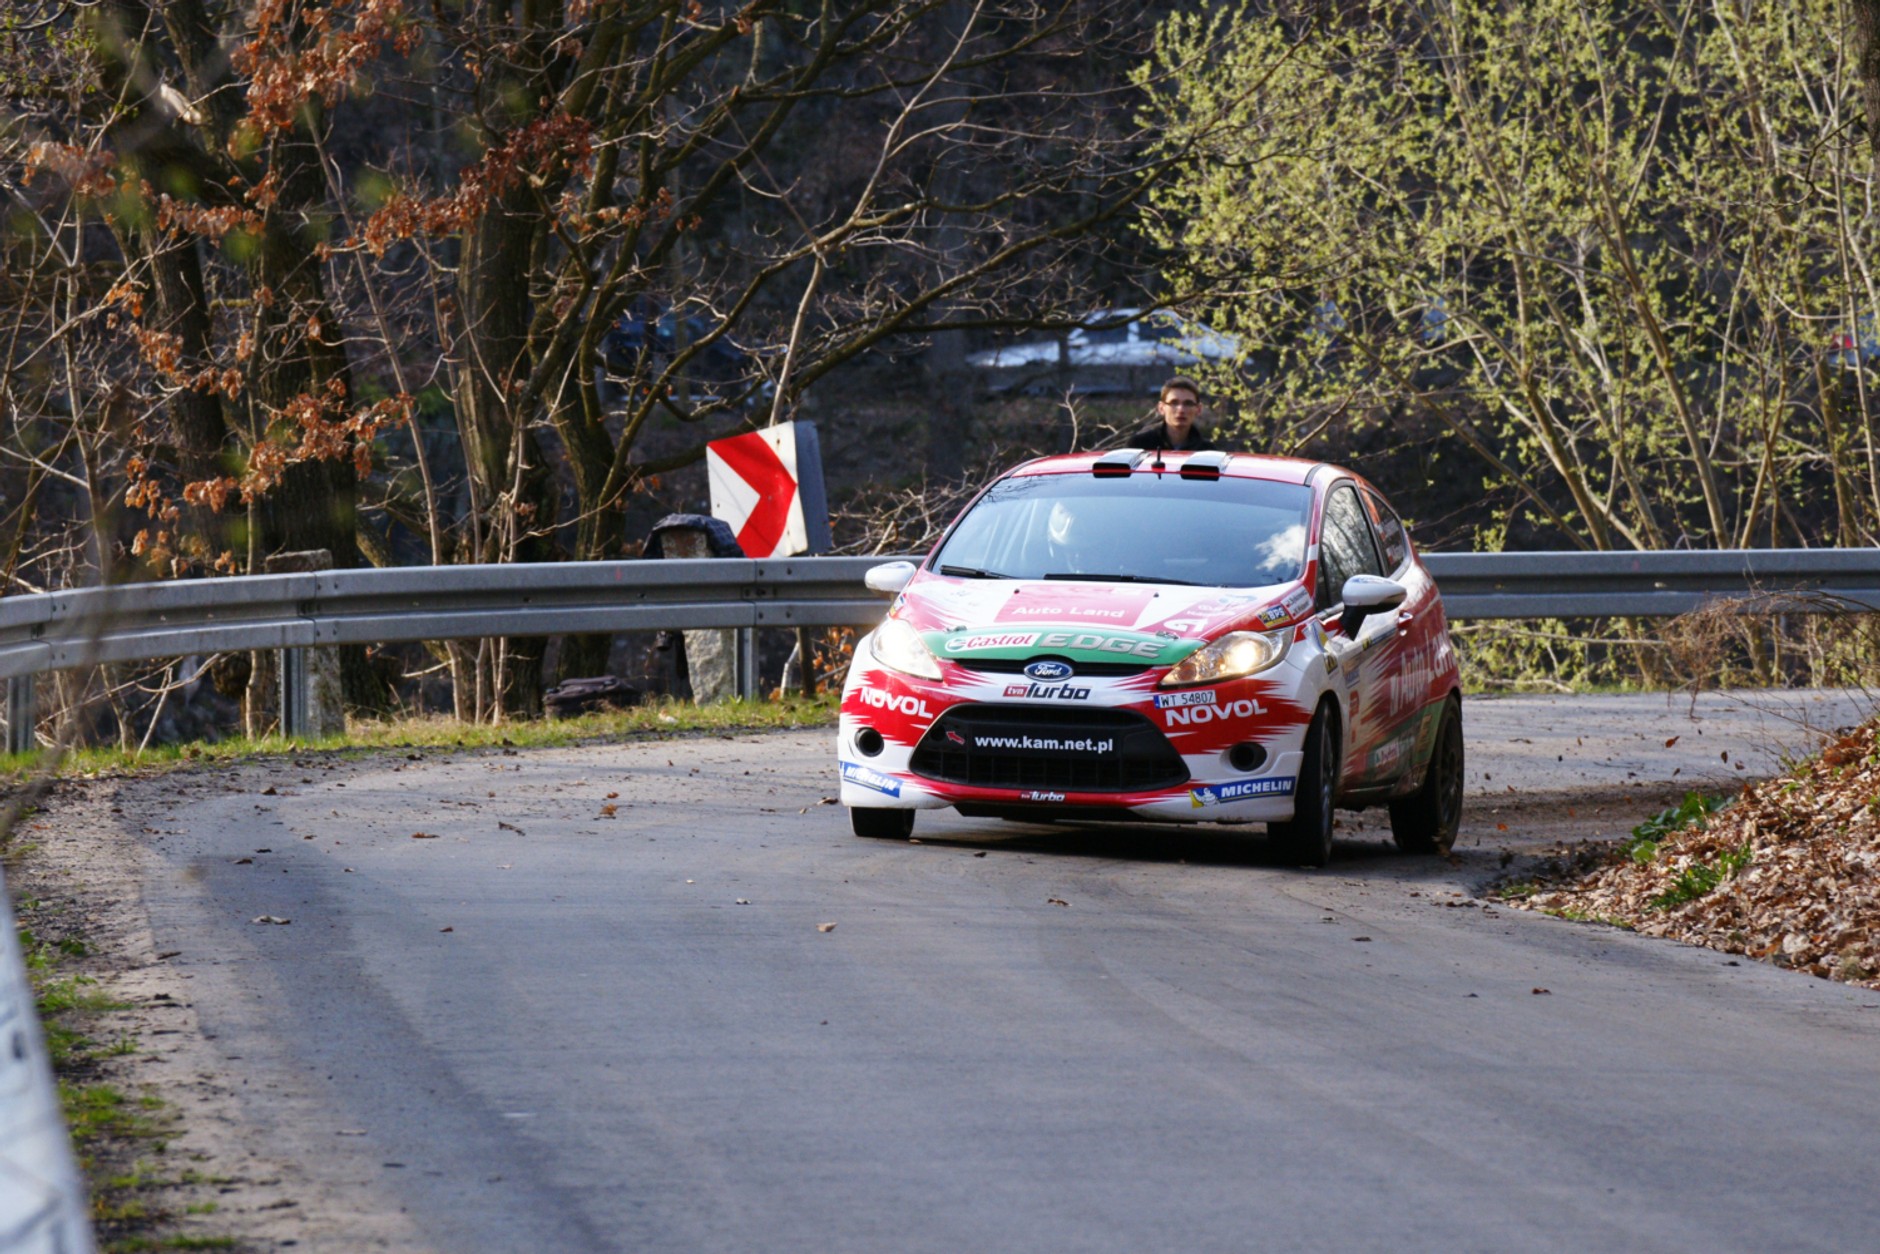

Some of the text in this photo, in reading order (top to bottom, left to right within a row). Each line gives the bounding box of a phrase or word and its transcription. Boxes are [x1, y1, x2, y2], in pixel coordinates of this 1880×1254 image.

[1012, 606, 1125, 619] Auto Land
[967, 633, 1168, 659] Castrol EDGE
[1034, 663, 1062, 676] Ford
[1006, 687, 1024, 696] tvn
[1161, 691, 1214, 706] WT 54807
[860, 686, 933, 719] NOVOL
[1165, 699, 1268, 726] NOVOL
[975, 736, 1113, 753] www.kam.net.pl
[1221, 780, 1292, 798] MICHELIN
